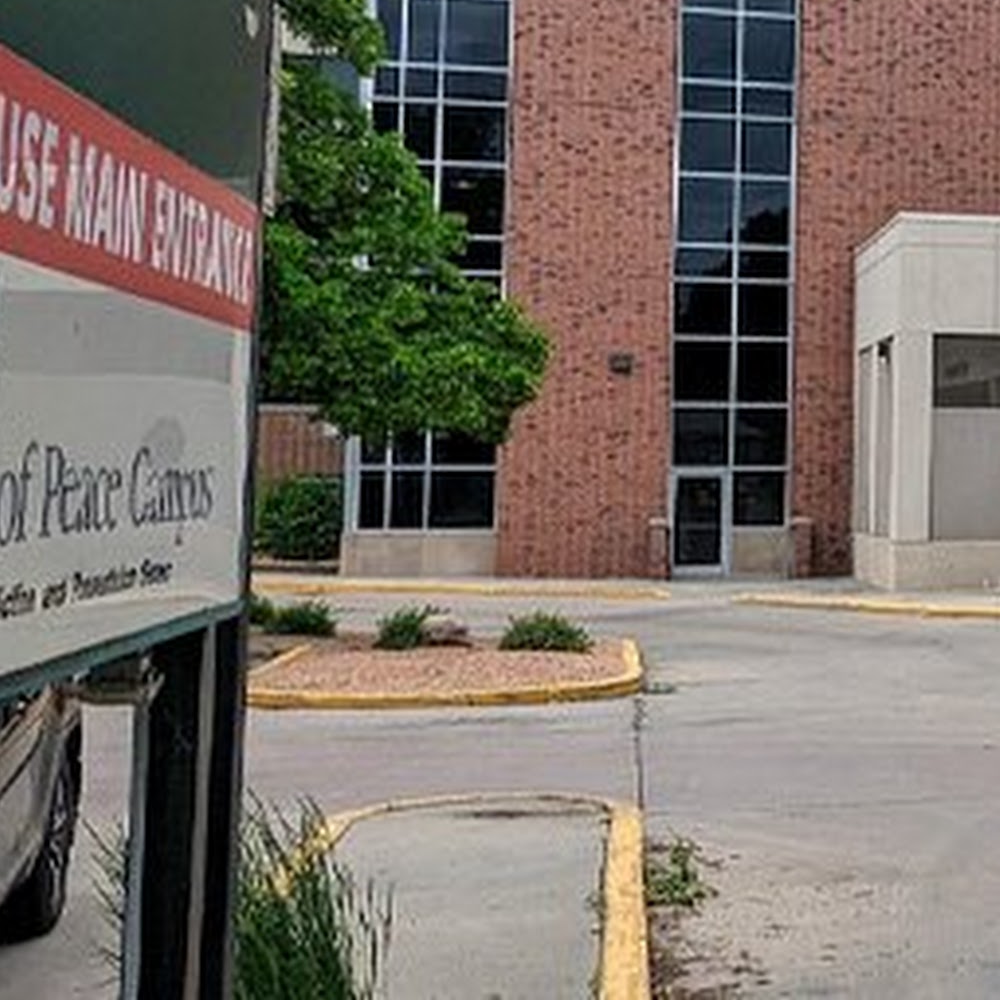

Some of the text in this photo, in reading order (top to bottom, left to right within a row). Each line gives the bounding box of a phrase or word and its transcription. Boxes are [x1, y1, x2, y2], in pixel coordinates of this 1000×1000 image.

[0, 92, 59, 229] USE
[64, 132, 148, 264] MAIN
[0, 440, 38, 547] of
[38, 446, 122, 539] Peace
